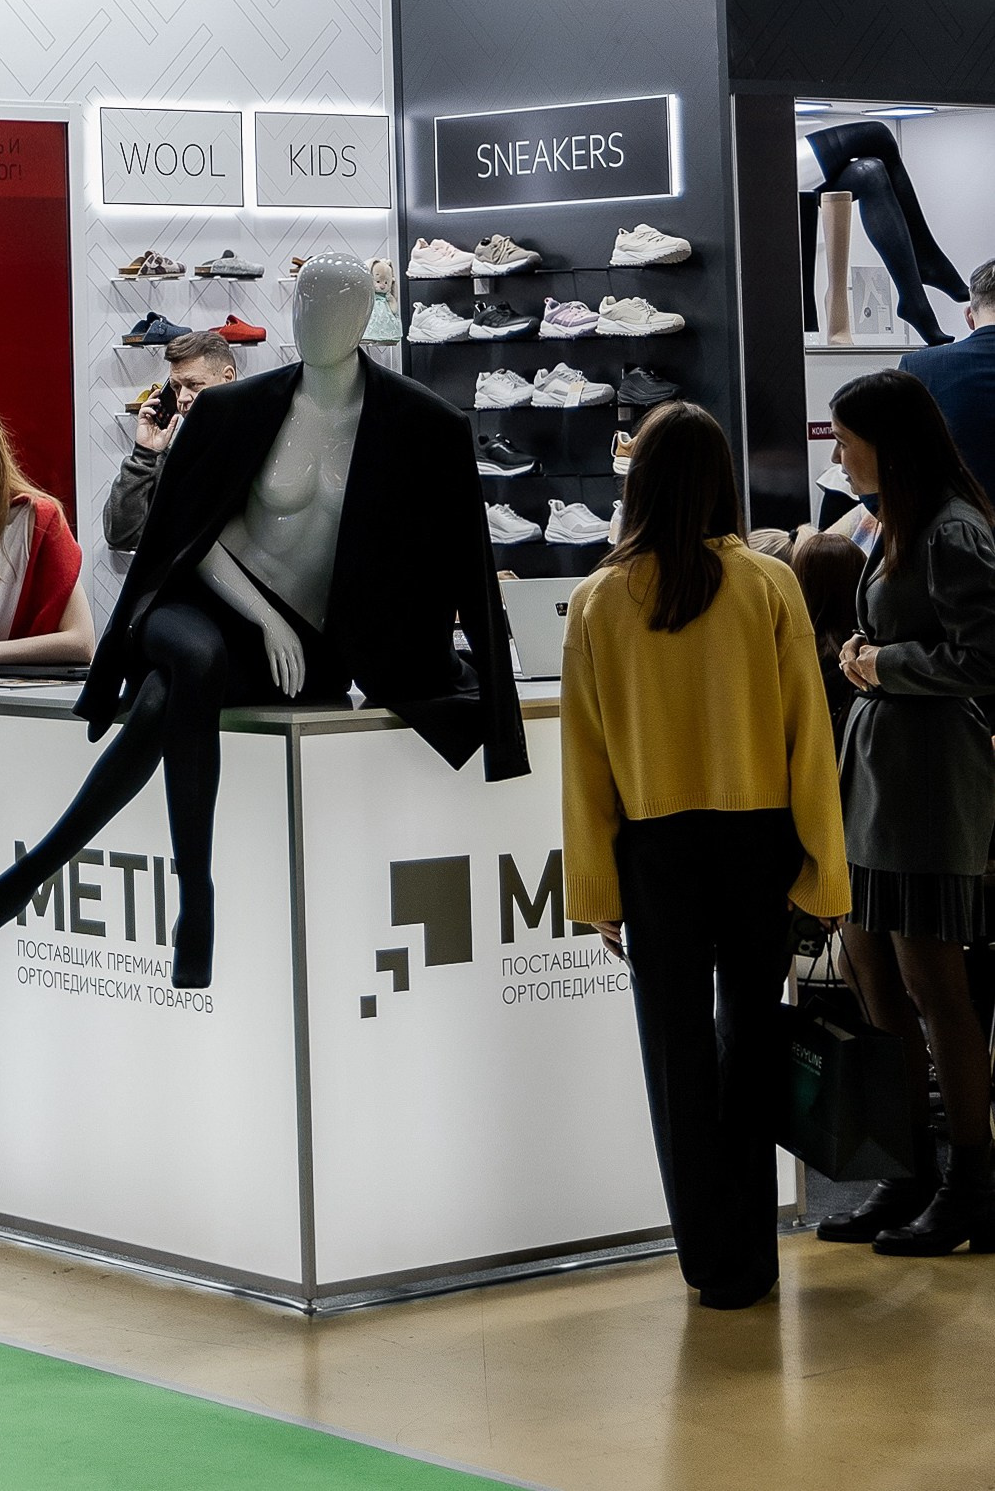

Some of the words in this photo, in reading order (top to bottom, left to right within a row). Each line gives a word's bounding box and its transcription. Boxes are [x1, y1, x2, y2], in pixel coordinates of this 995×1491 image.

[9, 139, 21, 154] И
[119, 142, 225, 177] WOOL
[289, 143, 357, 178] KIDS
[477, 132, 625, 180] SNEAKERS
[15, 840, 179, 948] METI
[17, 939, 103, 969] ПОСТАВЩИК
[107, 952, 173, 979] ПРЕМИАЛ
[502, 948, 612, 976] ПОСТАВЩИК
[17, 966, 142, 1002] ОРТОПЕДИЧЕСКИХ
[147, 986, 214, 1013] ТОВАРОВ
